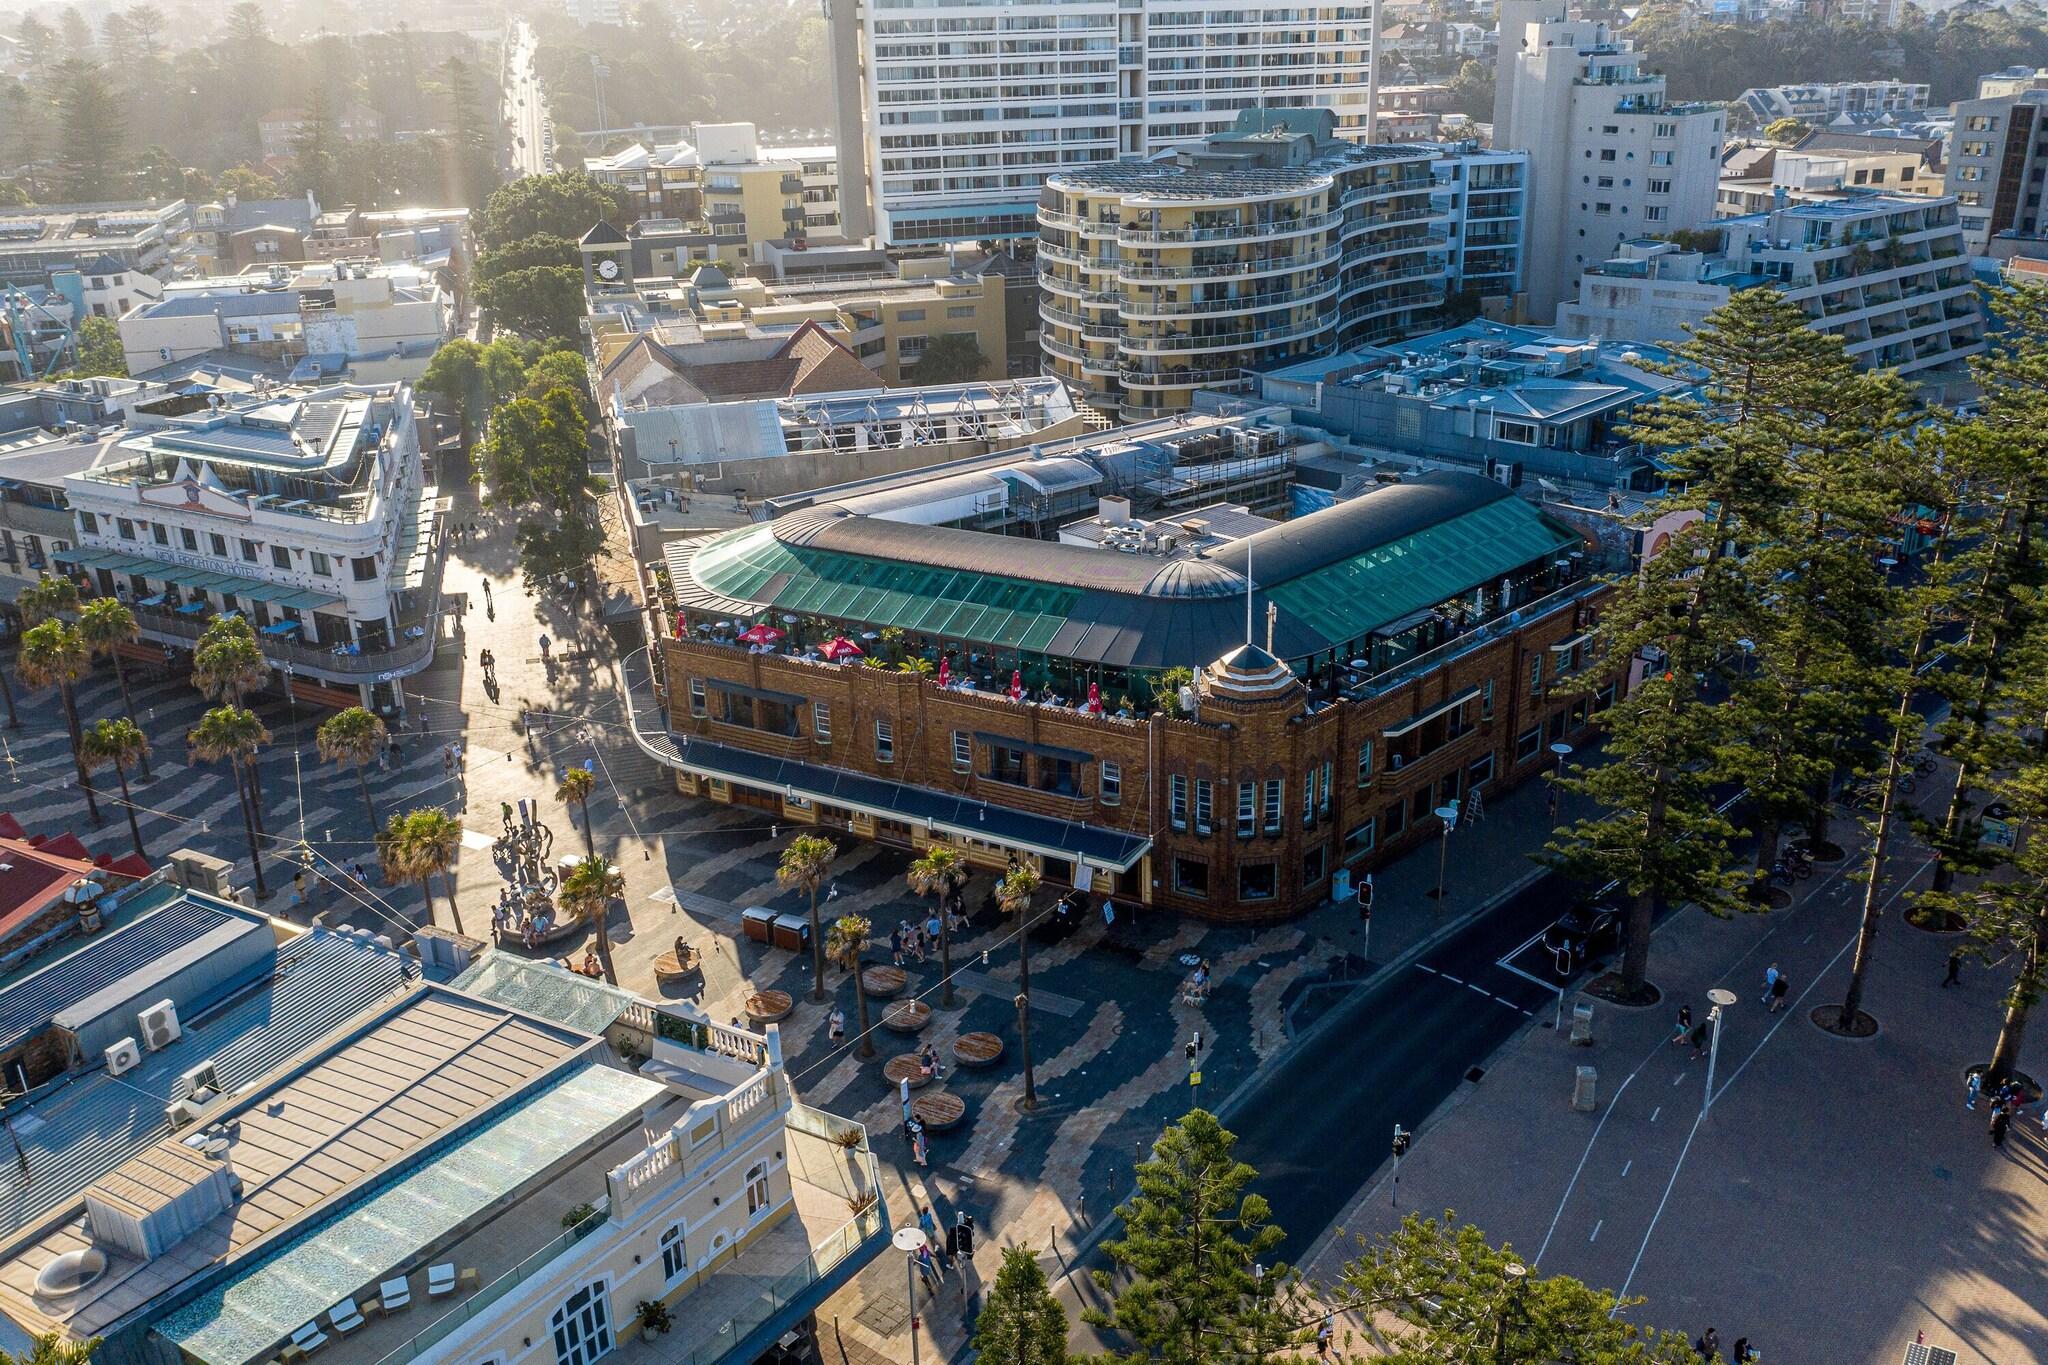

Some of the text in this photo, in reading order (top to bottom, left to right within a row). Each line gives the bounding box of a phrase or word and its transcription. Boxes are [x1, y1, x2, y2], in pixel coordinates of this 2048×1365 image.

[154, 550, 256, 577] NEW BRIGHTON HOTEL
